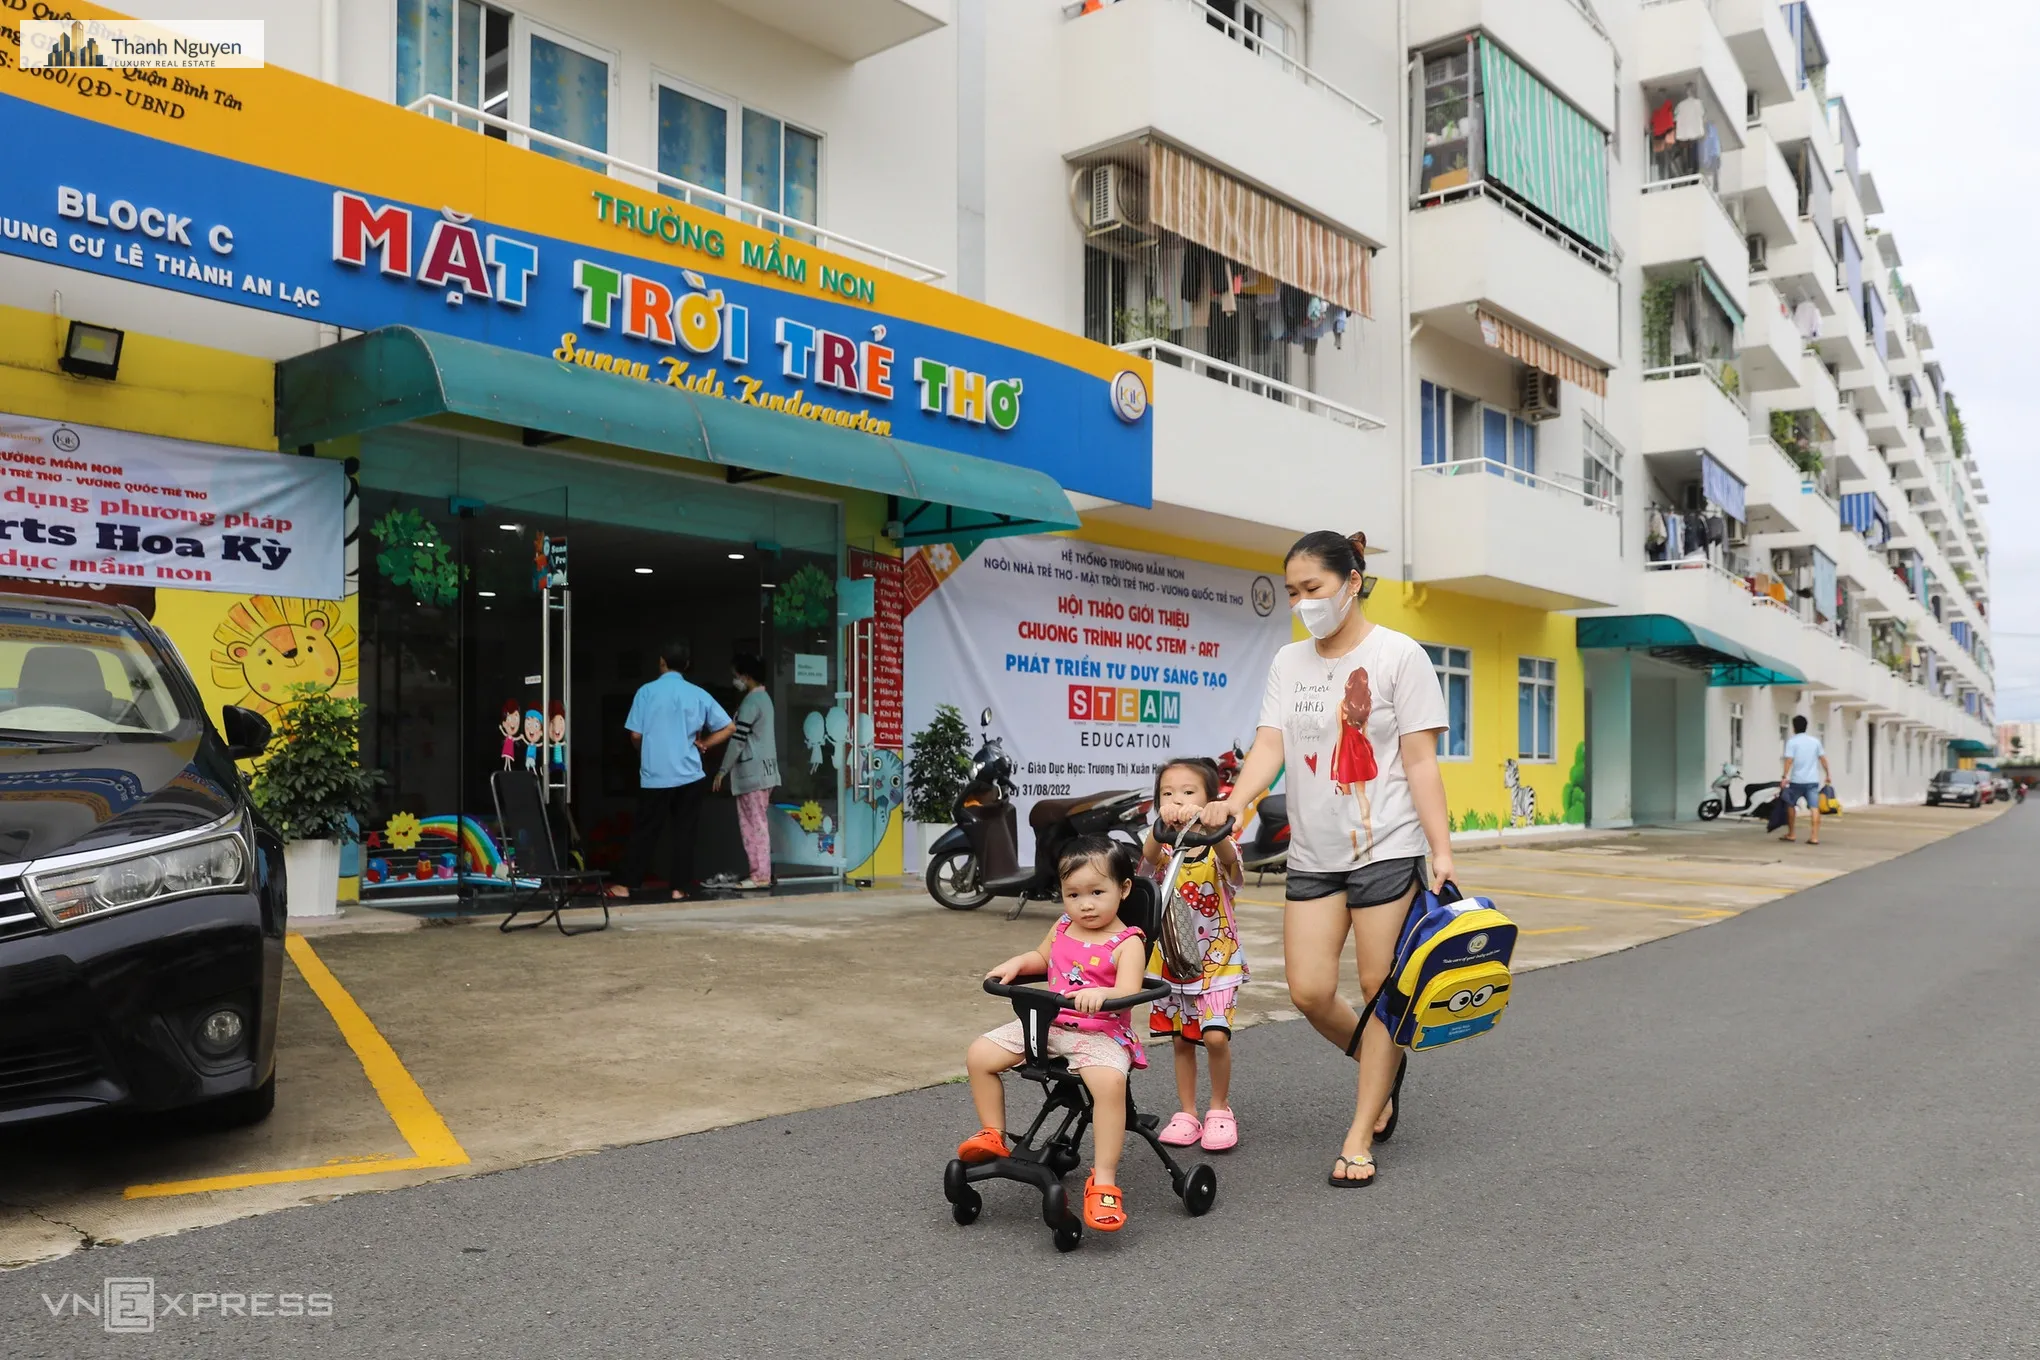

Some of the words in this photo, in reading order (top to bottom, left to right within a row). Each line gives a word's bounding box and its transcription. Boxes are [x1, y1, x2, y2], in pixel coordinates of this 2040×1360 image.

[171, 75, 209, 101] Bình
[213, 89, 243, 112] Tân
[58, 185, 192, 247] BLOCK
[208, 225, 234, 255] C
[0, 216, 58, 249] UNG
[69, 233, 105, 258] CƯ
[115, 244, 144, 268] LÊ
[155, 254, 234, 289] THÀNH
[242, 275, 272, 298] AN
[279, 282, 321, 308] LẠC
[591, 191, 725, 259] TRƯỜNG
[740, 238, 807, 283] MẦM
[819, 265, 875, 304] NON
[333, 190, 538, 308] MẶT
[573, 258, 749, 365] TRỜI
[775, 316, 894, 400] TRẺ
[914, 356, 1023, 431] THƠ
[654, 356, 726, 399] Kids
[0, 451, 46, 466] ƯỜNG
[91, 463, 123, 476] NON
[4, 485, 89, 513] dụng
[100, 499, 216, 527] phương
[224, 512, 293, 533] pháp
[95, 522, 205, 559] Hoa
[221, 535, 292, 570] Kỳ
[0, 548, 58, 572] dục
[70, 556, 144, 576] mầm
[156, 565, 212, 582] non
[984, 556, 1011, 572] NGÔI
[1013, 560, 1034, 576] NHÀ
[1037, 562, 1052, 578] TRẺ
[1054, 566, 1073, 580] THƠ
[1061, 550, 1073, 564] HỆ
[1076, 551, 1107, 568] THỐNG
[1110, 557, 1144, 574] TRƯỜNG
[1167, 567, 1185, 580] NON
[1058, 593, 1083, 618] HỘI
[1088, 597, 1124, 620] THẢO
[1129, 602, 1154, 624] GIỚI
[1158, 607, 1189, 632] THIỆU
[1018, 622, 1078, 644] CHƯƠNG
[1083, 626, 1123, 648] TRÌNH
[1127, 634, 1152, 655] HỌC
[1156, 636, 1187, 655] STEM
[1198, 641, 1220, 658] ART
[1006, 652, 1050, 674] PHÁT
[1055, 654, 1101, 679] TRIỂN
[1106, 662, 1126, 680] TƯ
[1131, 664, 1160, 683] DUY
[1163, 664, 1199, 686] SÁNG
[1203, 671, 1227, 691] TẠO
[1294, 680, 1306, 693] Do
[1309, 685, 1330, 693] more
[1072, 689, 1178, 720] STEAM
[1294, 700, 1325, 713] MAKES
[1081, 731, 1171, 749] EDUCATION
[1049, 762, 1064, 777] Dục
[1067, 762, 1085, 777] Học:
[1088, 762, 1115, 776] Trương
[1117, 763, 1129, 777] Thị
[1131, 764, 1150, 775] Xuân
[1022, 784, 1071, 797] 31/08/2022
